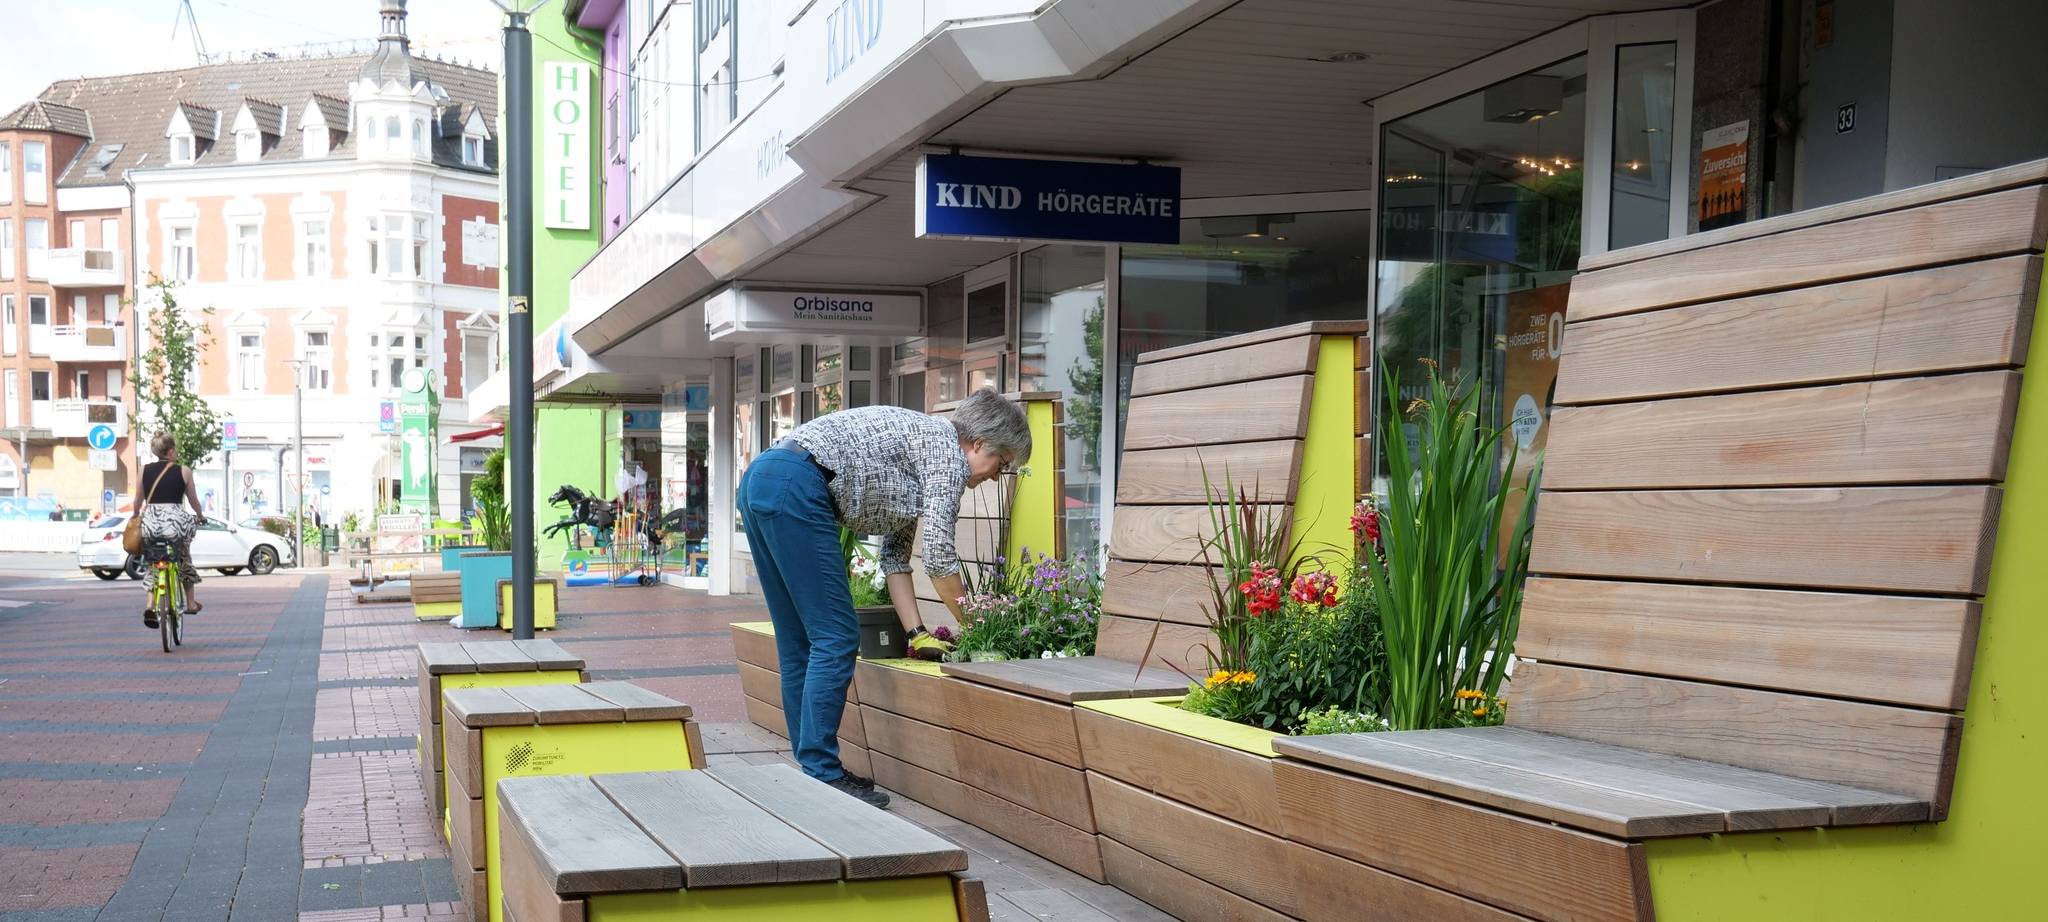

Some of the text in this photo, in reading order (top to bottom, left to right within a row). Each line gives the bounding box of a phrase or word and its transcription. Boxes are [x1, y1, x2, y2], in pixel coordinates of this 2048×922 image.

[826, 0, 885, 86] KIND
[1839, 108, 1854, 130] 33
[553, 65, 580, 223] HOTEL
[935, 182, 1173, 218] KIND HÖRGERÄTE
[793, 296, 873, 313] Orbisana
[794, 312, 873, 321] Mein Sanitätshaus
